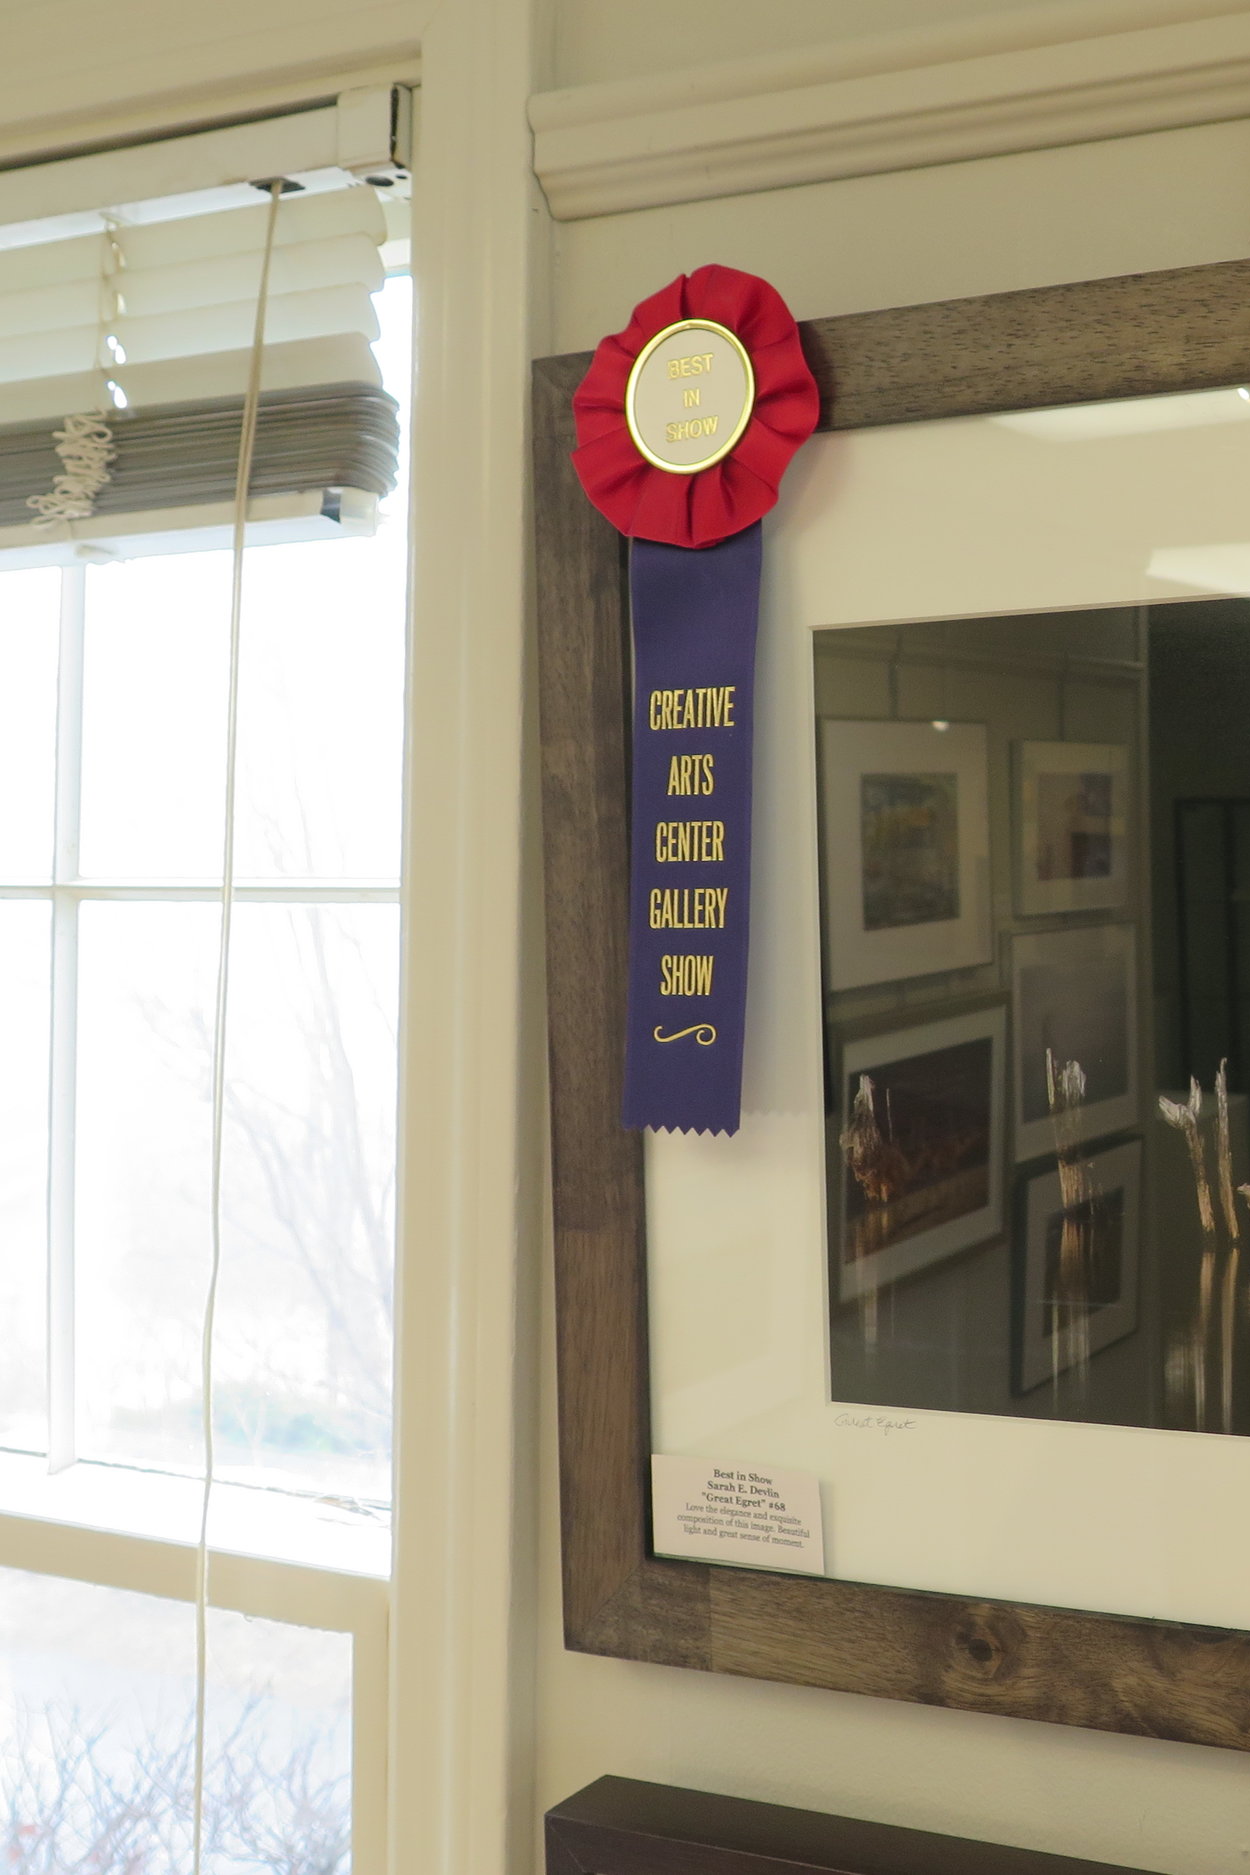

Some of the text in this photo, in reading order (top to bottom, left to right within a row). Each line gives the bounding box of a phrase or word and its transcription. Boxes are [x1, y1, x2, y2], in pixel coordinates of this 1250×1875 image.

[667, 353, 714, 380] BEST
[683, 388, 701, 408] IN
[666, 416, 718, 443] SHOW
[649, 686, 736, 730] CREATIVE
[667, 753, 714, 796] ARTS
[655, 820, 725, 863] CENTER
[649, 888, 728, 930] GALLERY
[660, 955, 714, 996] SHOW
[707, 1480, 779, 1498] Sarah E. Devlin
[713, 1468, 772, 1485] Best in Show
[686, 1502, 801, 1526] Love the elegance and exquisite
[702, 1491, 786, 1512] "Great Egret" #68
[677, 1514, 810, 1538] composition of this image. Beautiful
[683, 1523, 804, 1548] light and great sense of moment.
